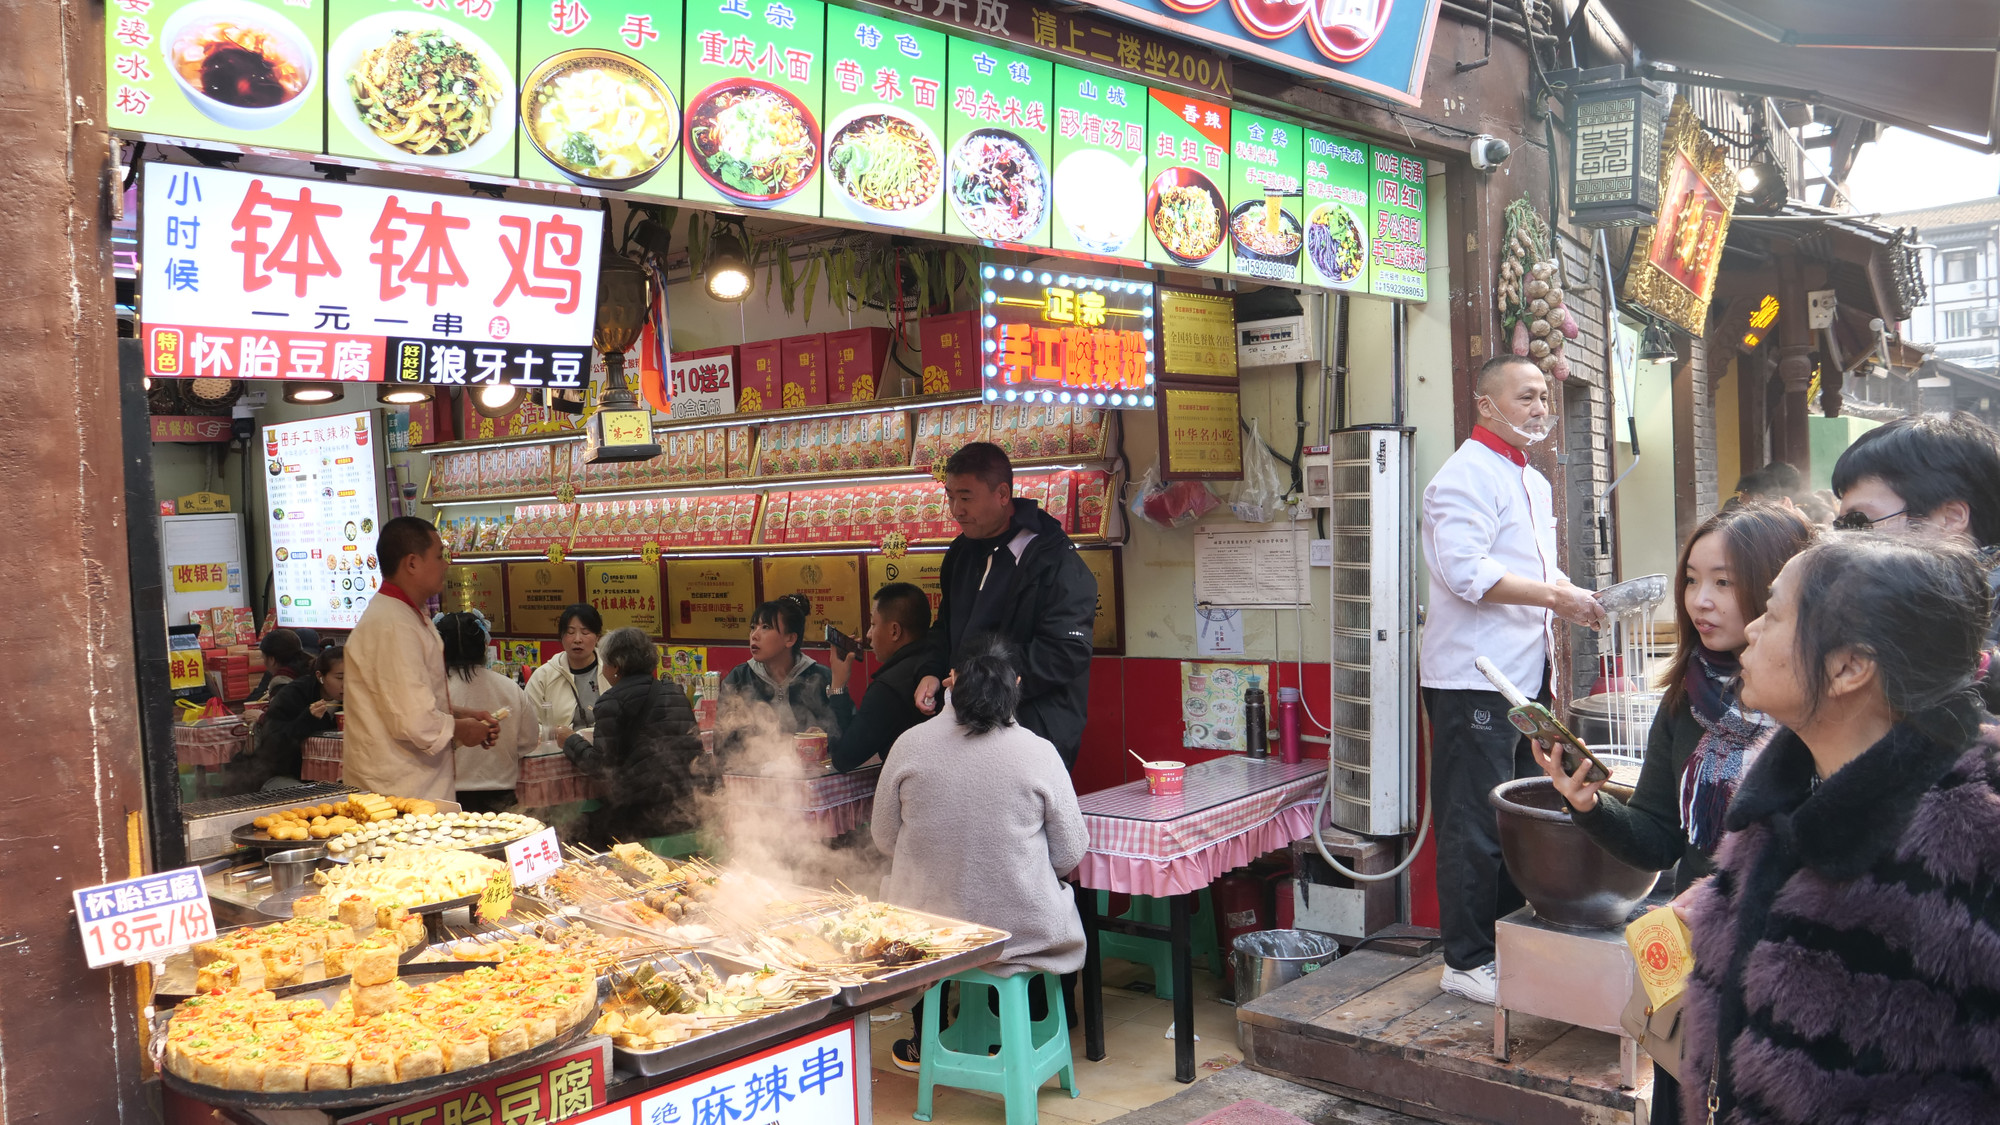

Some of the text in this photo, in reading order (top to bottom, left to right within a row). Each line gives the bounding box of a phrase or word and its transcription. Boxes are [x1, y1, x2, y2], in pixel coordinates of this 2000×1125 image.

[551, 0, 658, 47] 抄手
[720, 0, 794, 28] 正宗
[699, 31, 813, 83] 重庆小面
[856, 25, 921, 58] 特色
[1032, 10, 1232, 97] 请上二楼坐200人
[835, 60, 939, 110] 营养面
[973, 54, 1031, 84] 古镇
[955, 87, 1047, 132] 鸡杂米线
[1079, 80, 1126, 107] 山城
[1059, 107, 1143, 152] 醪糟汤圆
[1182, 104, 1222, 129] 香辣
[1157, 133, 1223, 169] 担担面
[1248, 123, 1288, 147] 金奖
[1309, 138, 1365, 164] 100年传承
[1246, 168, 1299, 192] 手工酸辣粉
[1306, 161, 1329, 179] 经典
[164, 171, 203, 292] 小时候
[1378, 210, 1422, 245] 罗公祖制
[231, 178, 583, 314] 钵钵鸡
[1371, 238, 1427, 275] 手工酸辣粉
[1246, 257, 1296, 280] 15922988053
[251, 304, 509, 339] 一元一串 起
[1042, 287, 1106, 326] 正宗
[156, 333, 178, 372] 特色
[189, 334, 372, 381] 怀胎豆腐
[402, 344, 420, 382] 好好吃
[429, 345, 584, 388] 狼牙土豆
[998, 323, 1147, 391] 手工酸辣粉
[156, 421, 195, 436] 点餐处
[290, 425, 351, 445] 手工酸辣粉
[613, 426, 643, 440] 第一名
[1174, 428, 1234, 441] 中华名小吃
[178, 564, 223, 583] 收银台
[171, 659, 200, 679] 银台
[515, 839, 553, 873] 一元一串
[85, 873, 198, 919] 怀胎豆腐
[89, 903, 209, 956] 18元/份
[389, 1058, 593, 1125] 胎豆腐
[692, 1046, 844, 1125] 麻辣串
